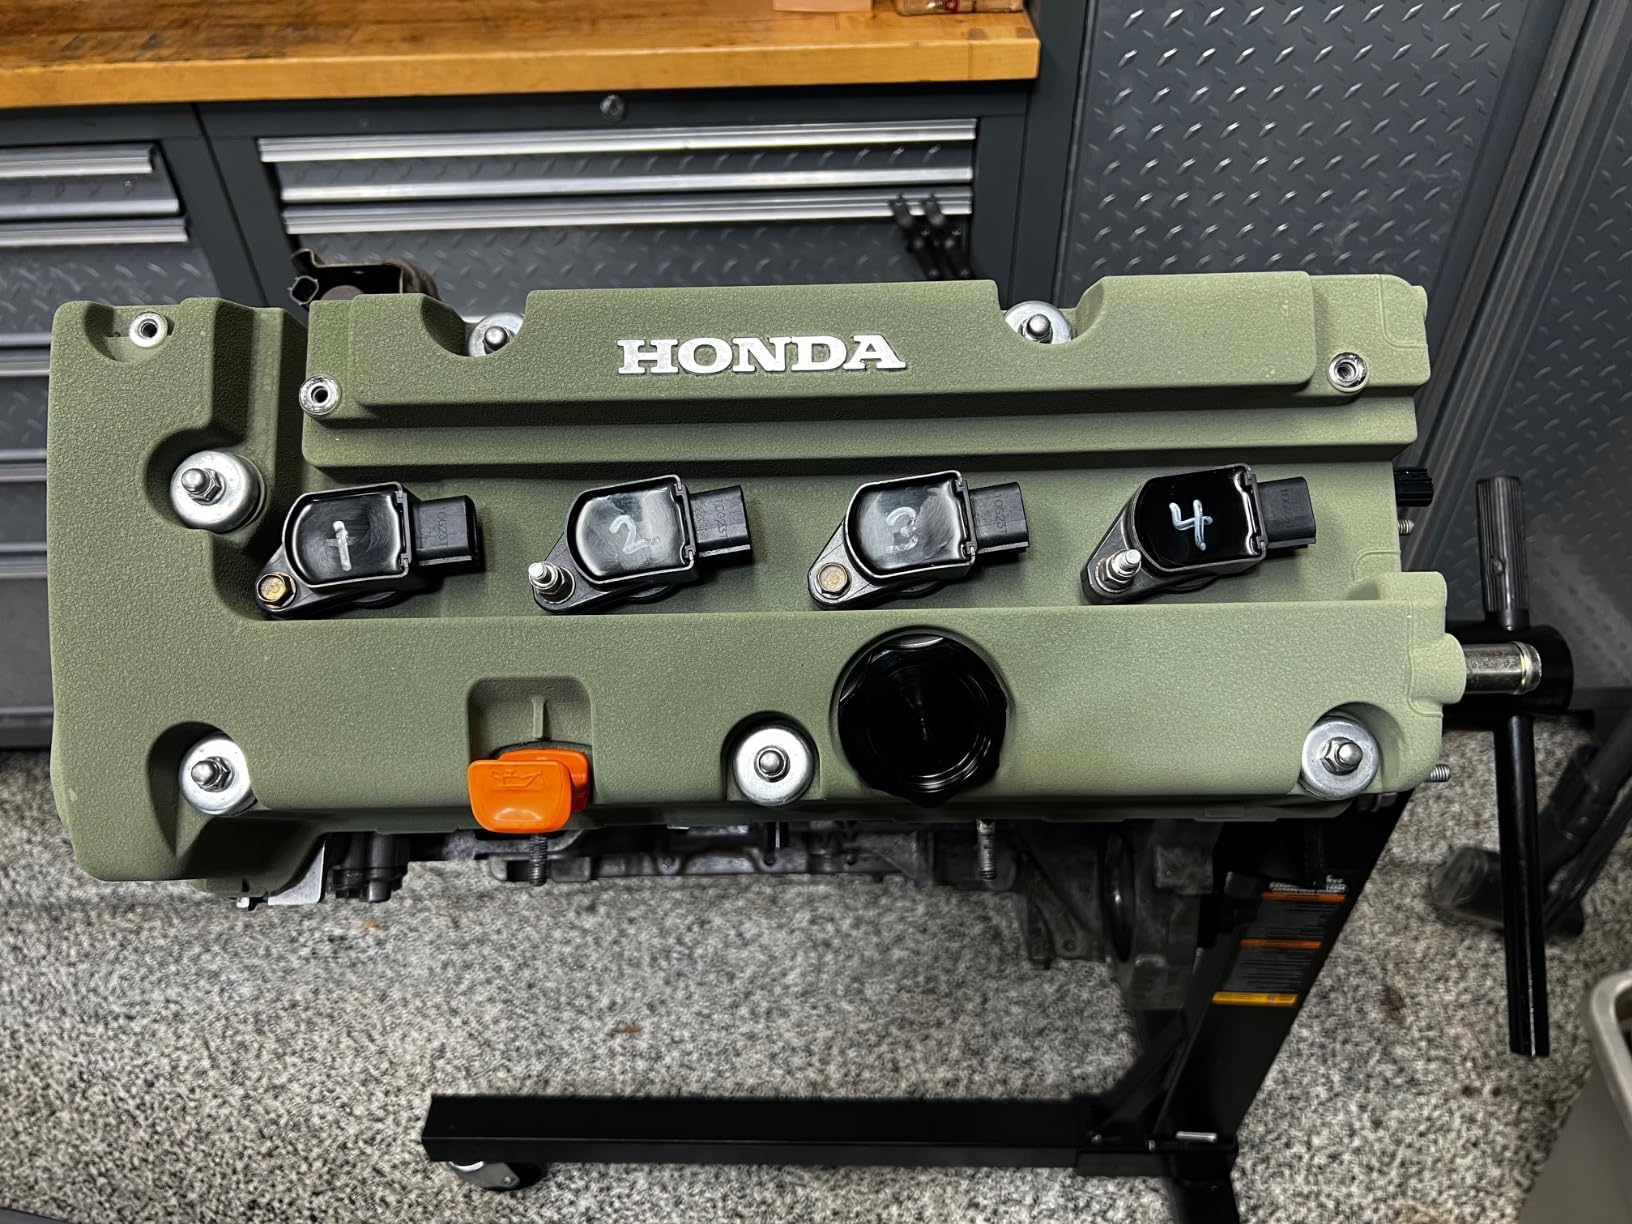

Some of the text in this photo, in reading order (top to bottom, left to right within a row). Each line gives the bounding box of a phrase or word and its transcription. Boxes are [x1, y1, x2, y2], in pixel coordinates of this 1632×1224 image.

[617, 334, 906, 374] HONDA
[333, 520, 351, 571] 1
[609, 515, 656, 554] 2
[886, 506, 919, 553] 3
[1169, 499, 1213, 551] 4
